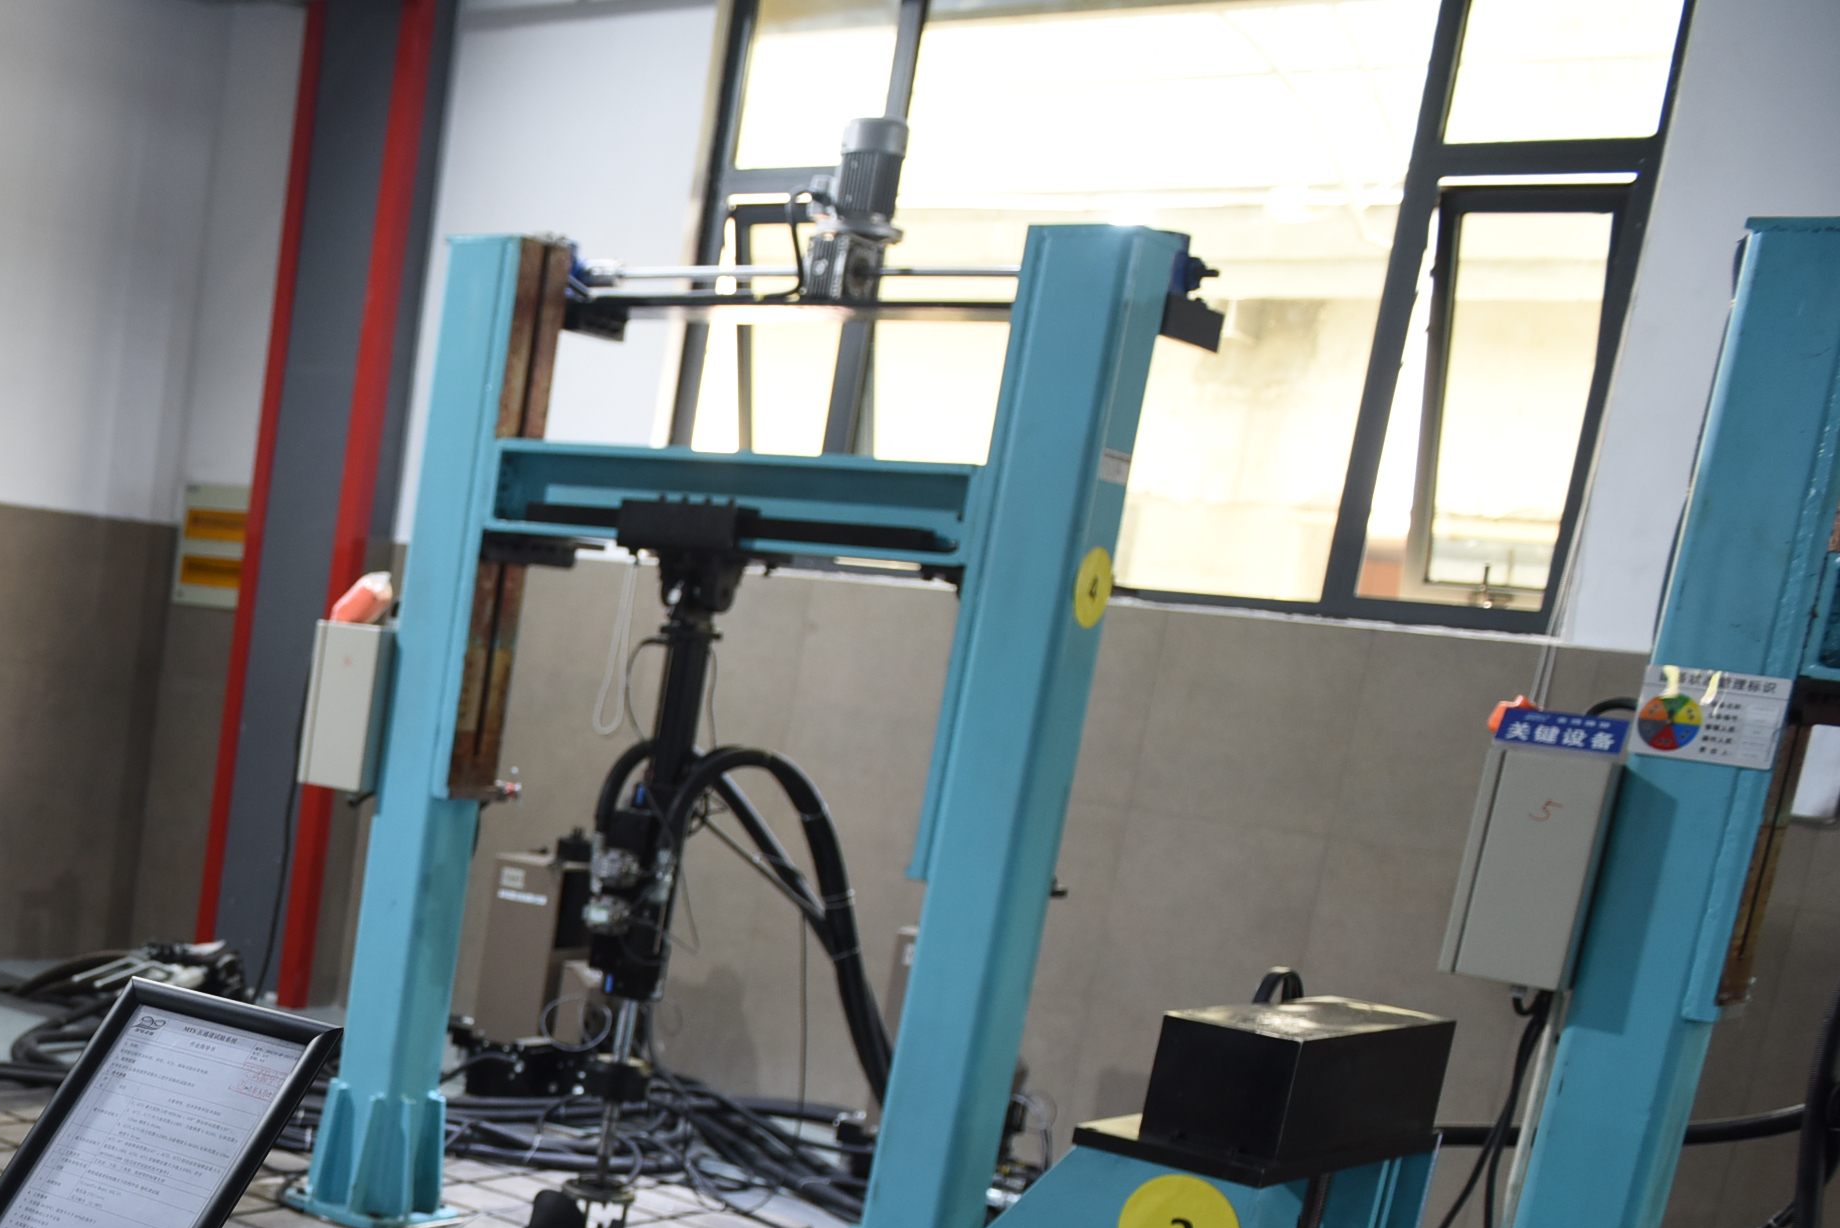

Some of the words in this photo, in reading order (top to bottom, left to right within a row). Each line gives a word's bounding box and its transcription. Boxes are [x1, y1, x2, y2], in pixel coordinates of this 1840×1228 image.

[1089, 575, 1098, 600] 4
[1505, 721, 1615, 751] 关键设备
[1529, 799, 1563, 822] 5
